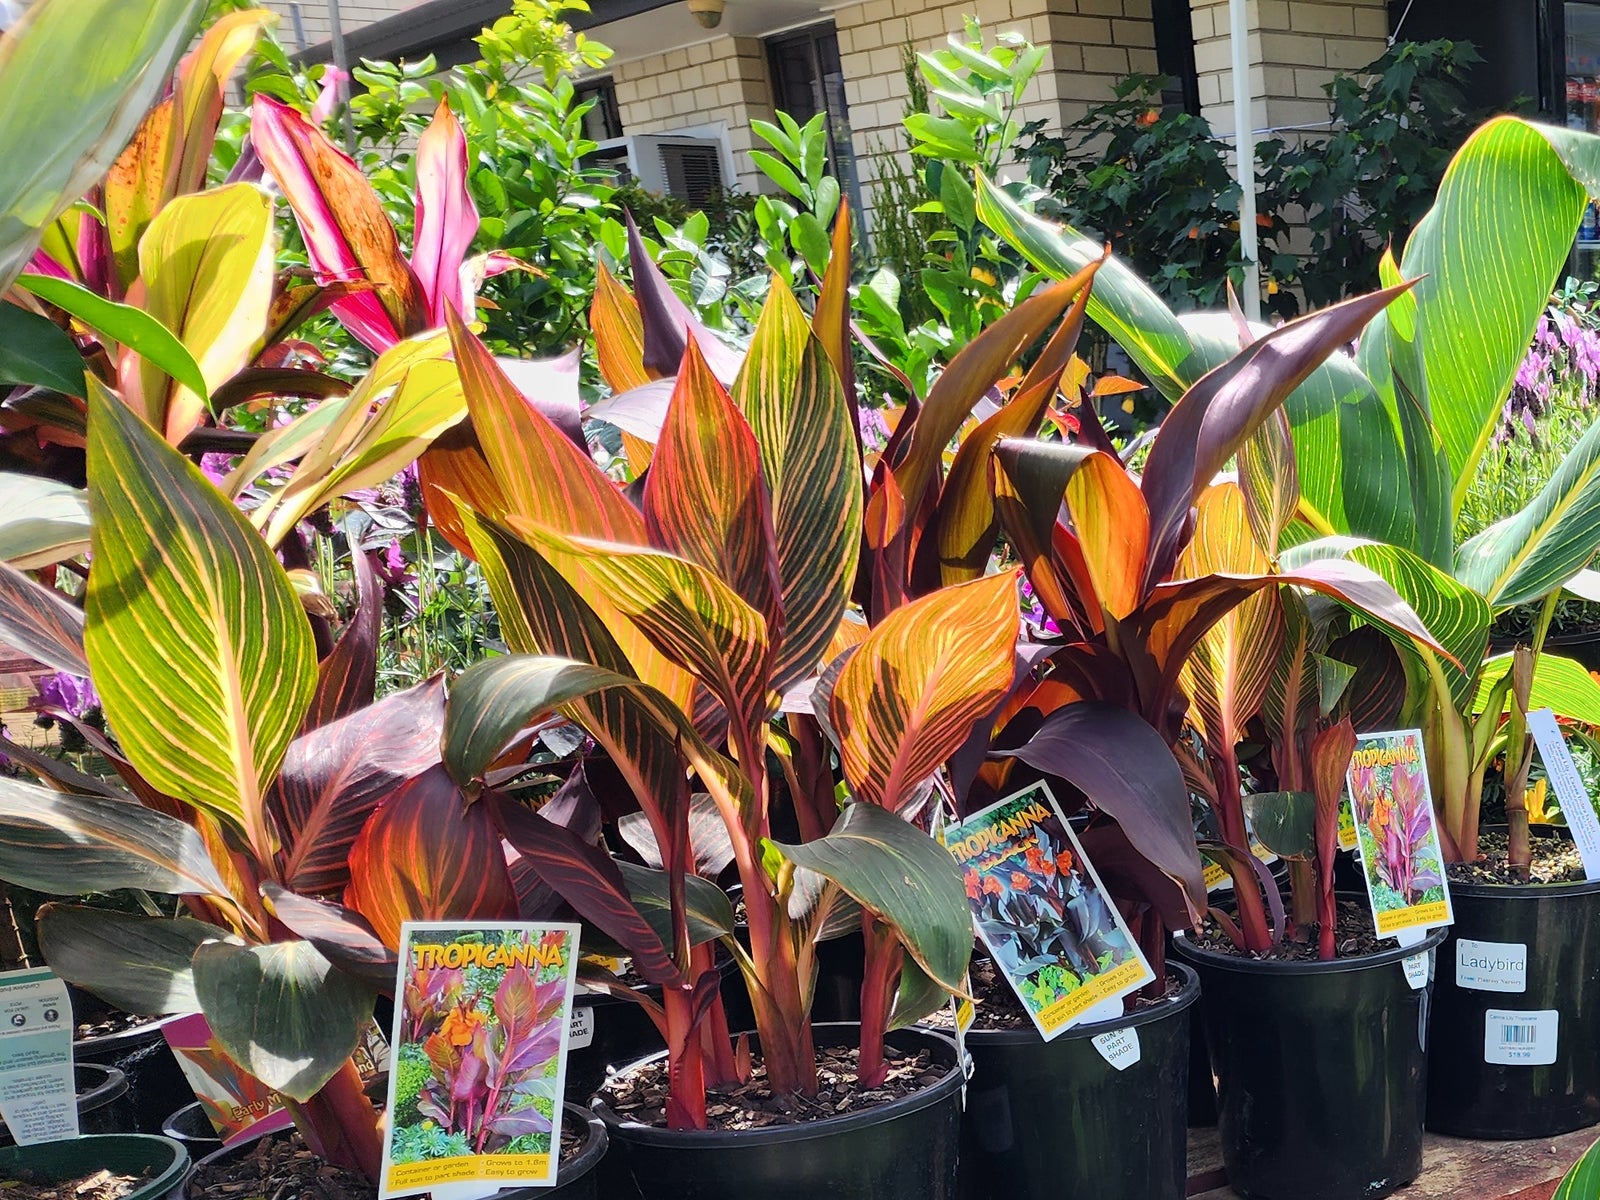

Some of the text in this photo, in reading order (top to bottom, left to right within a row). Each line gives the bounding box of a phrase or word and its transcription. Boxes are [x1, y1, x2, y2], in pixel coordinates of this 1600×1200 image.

[948, 802, 1052, 866] TROPICANNA
[979, 835, 1040, 872] BLACK
[413, 943, 564, 970] TROPICANNA
[1461, 953, 1524, 973] Ladybird
[569, 1028, 588, 1038] ADE
[1106, 1036, 1126, 1052] PART
[1108, 1043, 1134, 1061] SHADE
[232, 1100, 265, 1120] Early
[395, 1166, 431, 1177] Container
[443, 1160, 470, 1172] garden
[486, 1159, 512, 1167] Grows
[394, 1177, 408, 1186] Full
[410, 1176, 423, 1185] sun
[434, 1171, 451, 1181] part
[452, 1169, 475, 1178] shade
[485, 1168, 504, 1176] Easy
